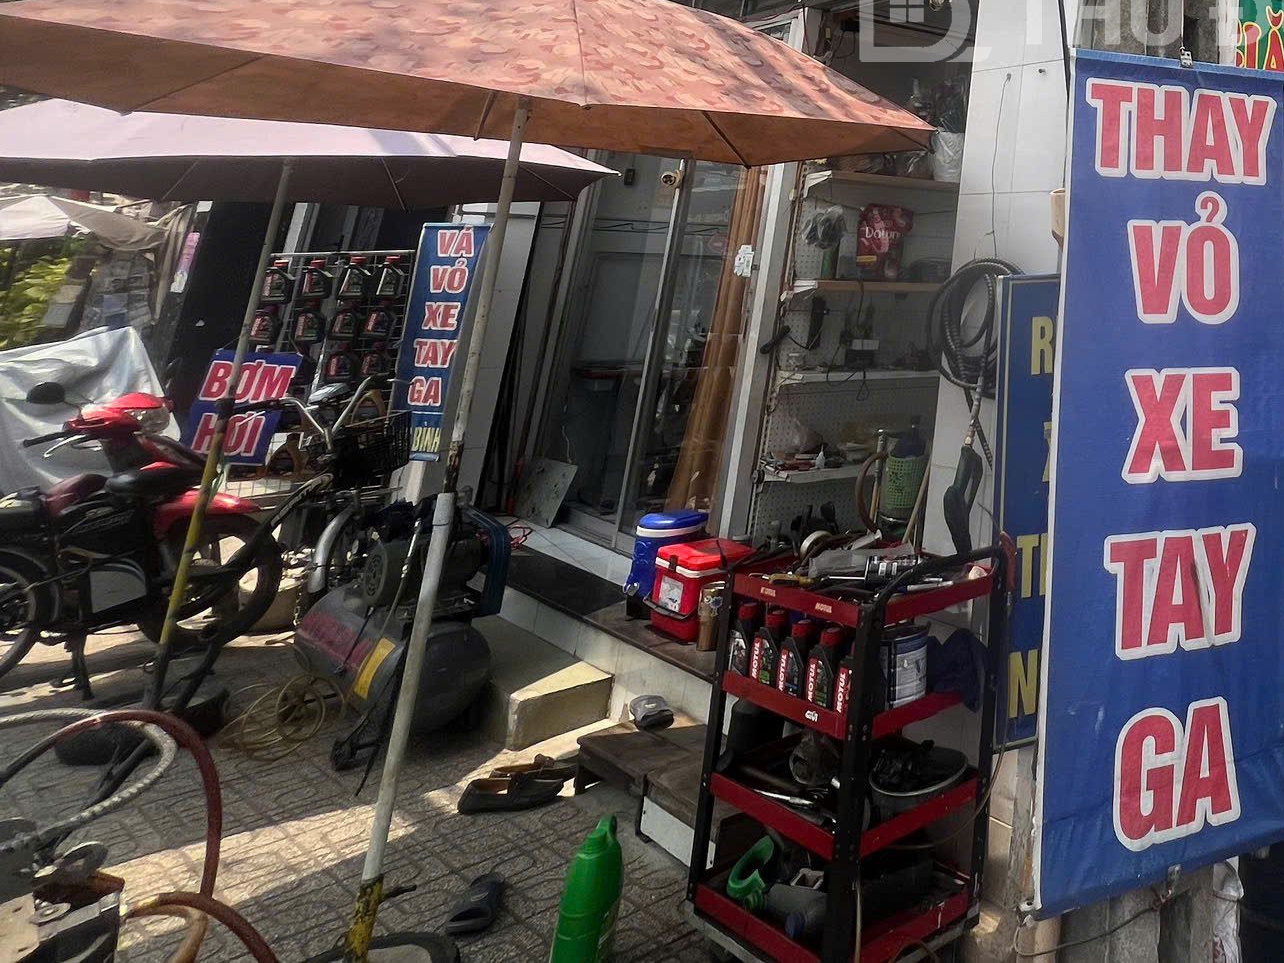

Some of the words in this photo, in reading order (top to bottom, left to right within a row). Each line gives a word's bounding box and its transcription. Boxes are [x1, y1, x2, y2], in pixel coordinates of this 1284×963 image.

[1086, 77, 1277, 186] THAY
[430, 258, 468, 293] VỎ
[1126, 190, 1240, 325] VỎ
[421, 301, 461, 330] XE
[413, 339, 458, 368] TAY
[199, 360, 296, 403] BƠM
[407, 376, 442, 406] GA
[1121, 366, 1245, 485] XE
[1103, 522, 1257, 662] TAY
[751, 641, 761, 679] MOTUL
[778, 652, 788, 692] MOTUL
[807, 662, 816, 702] MOTUL
[836, 672, 846, 713] MOTUL
[1113, 696, 1241, 852] GA
